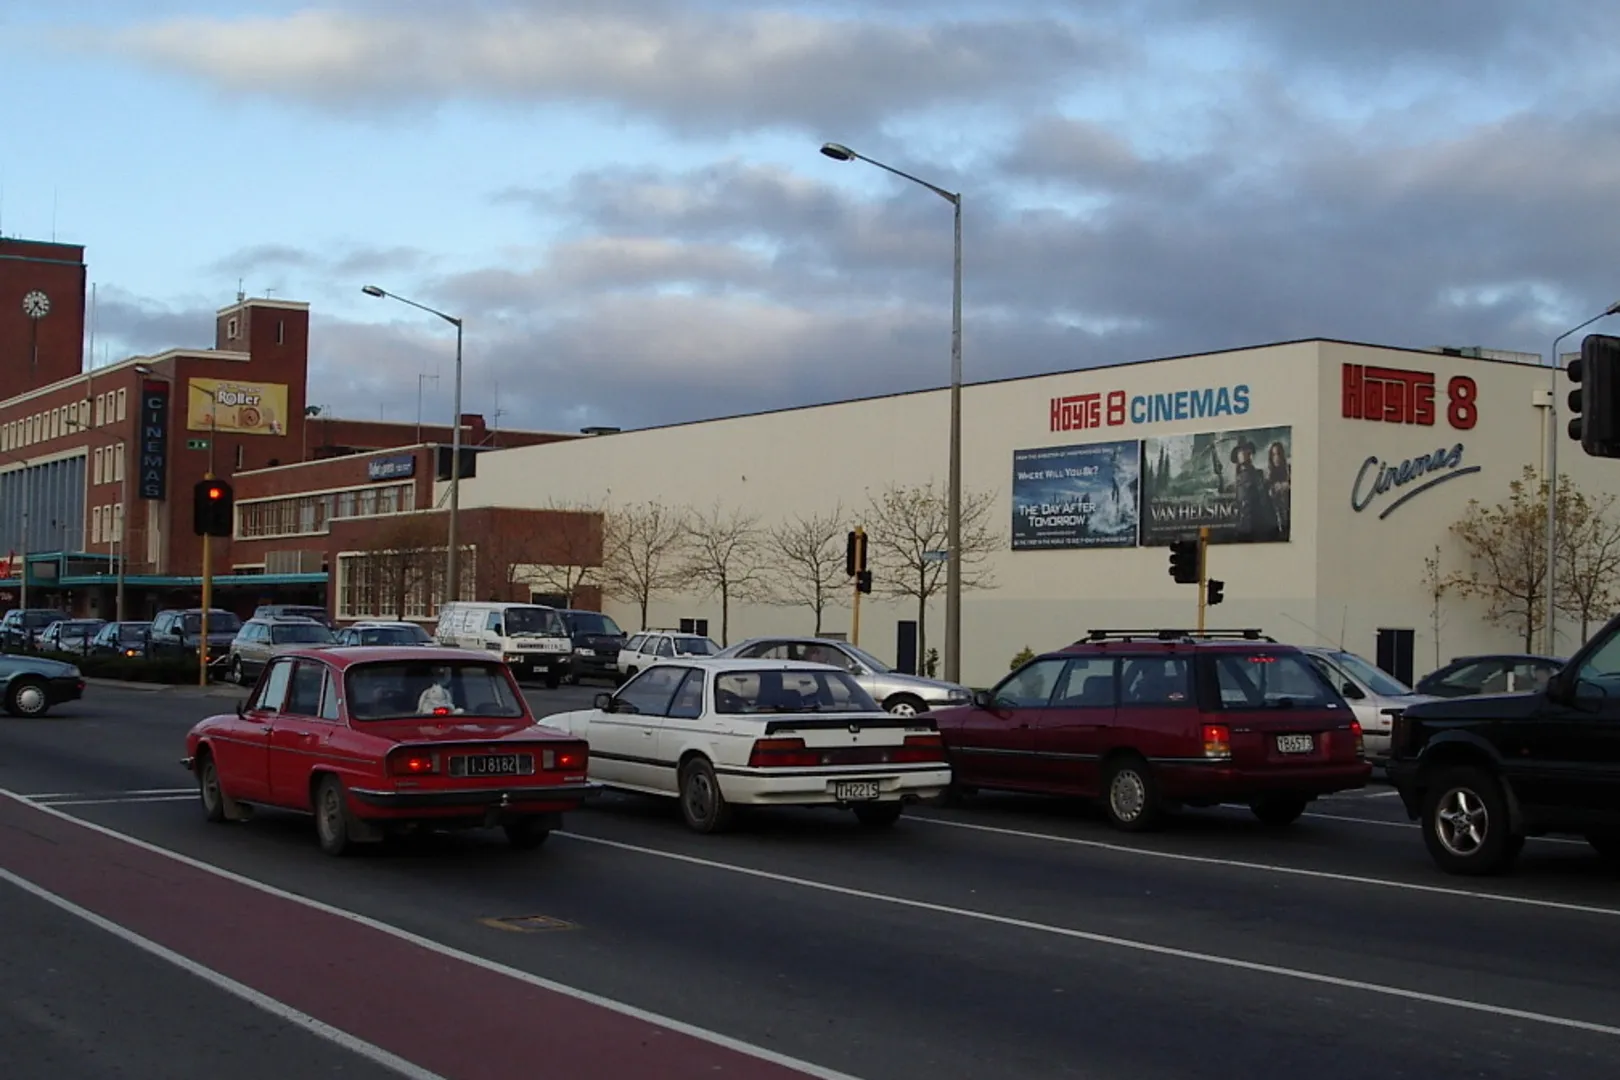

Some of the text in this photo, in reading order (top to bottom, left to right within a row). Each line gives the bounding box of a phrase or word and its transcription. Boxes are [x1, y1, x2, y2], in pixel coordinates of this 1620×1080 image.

[1107, 390, 1126, 426] 8
[1131, 384, 1250, 424] CINEMAS
[1447, 375, 1478, 430] 8
[144, 397, 163, 497] CINEMAS
[1351, 443, 1464, 512] Cinemas
[1019, 502, 1096, 516] THE DAY AFTER
[1028, 515, 1086, 528] TOMORROW
[1151, 502, 1239, 520] VAN HELSING
